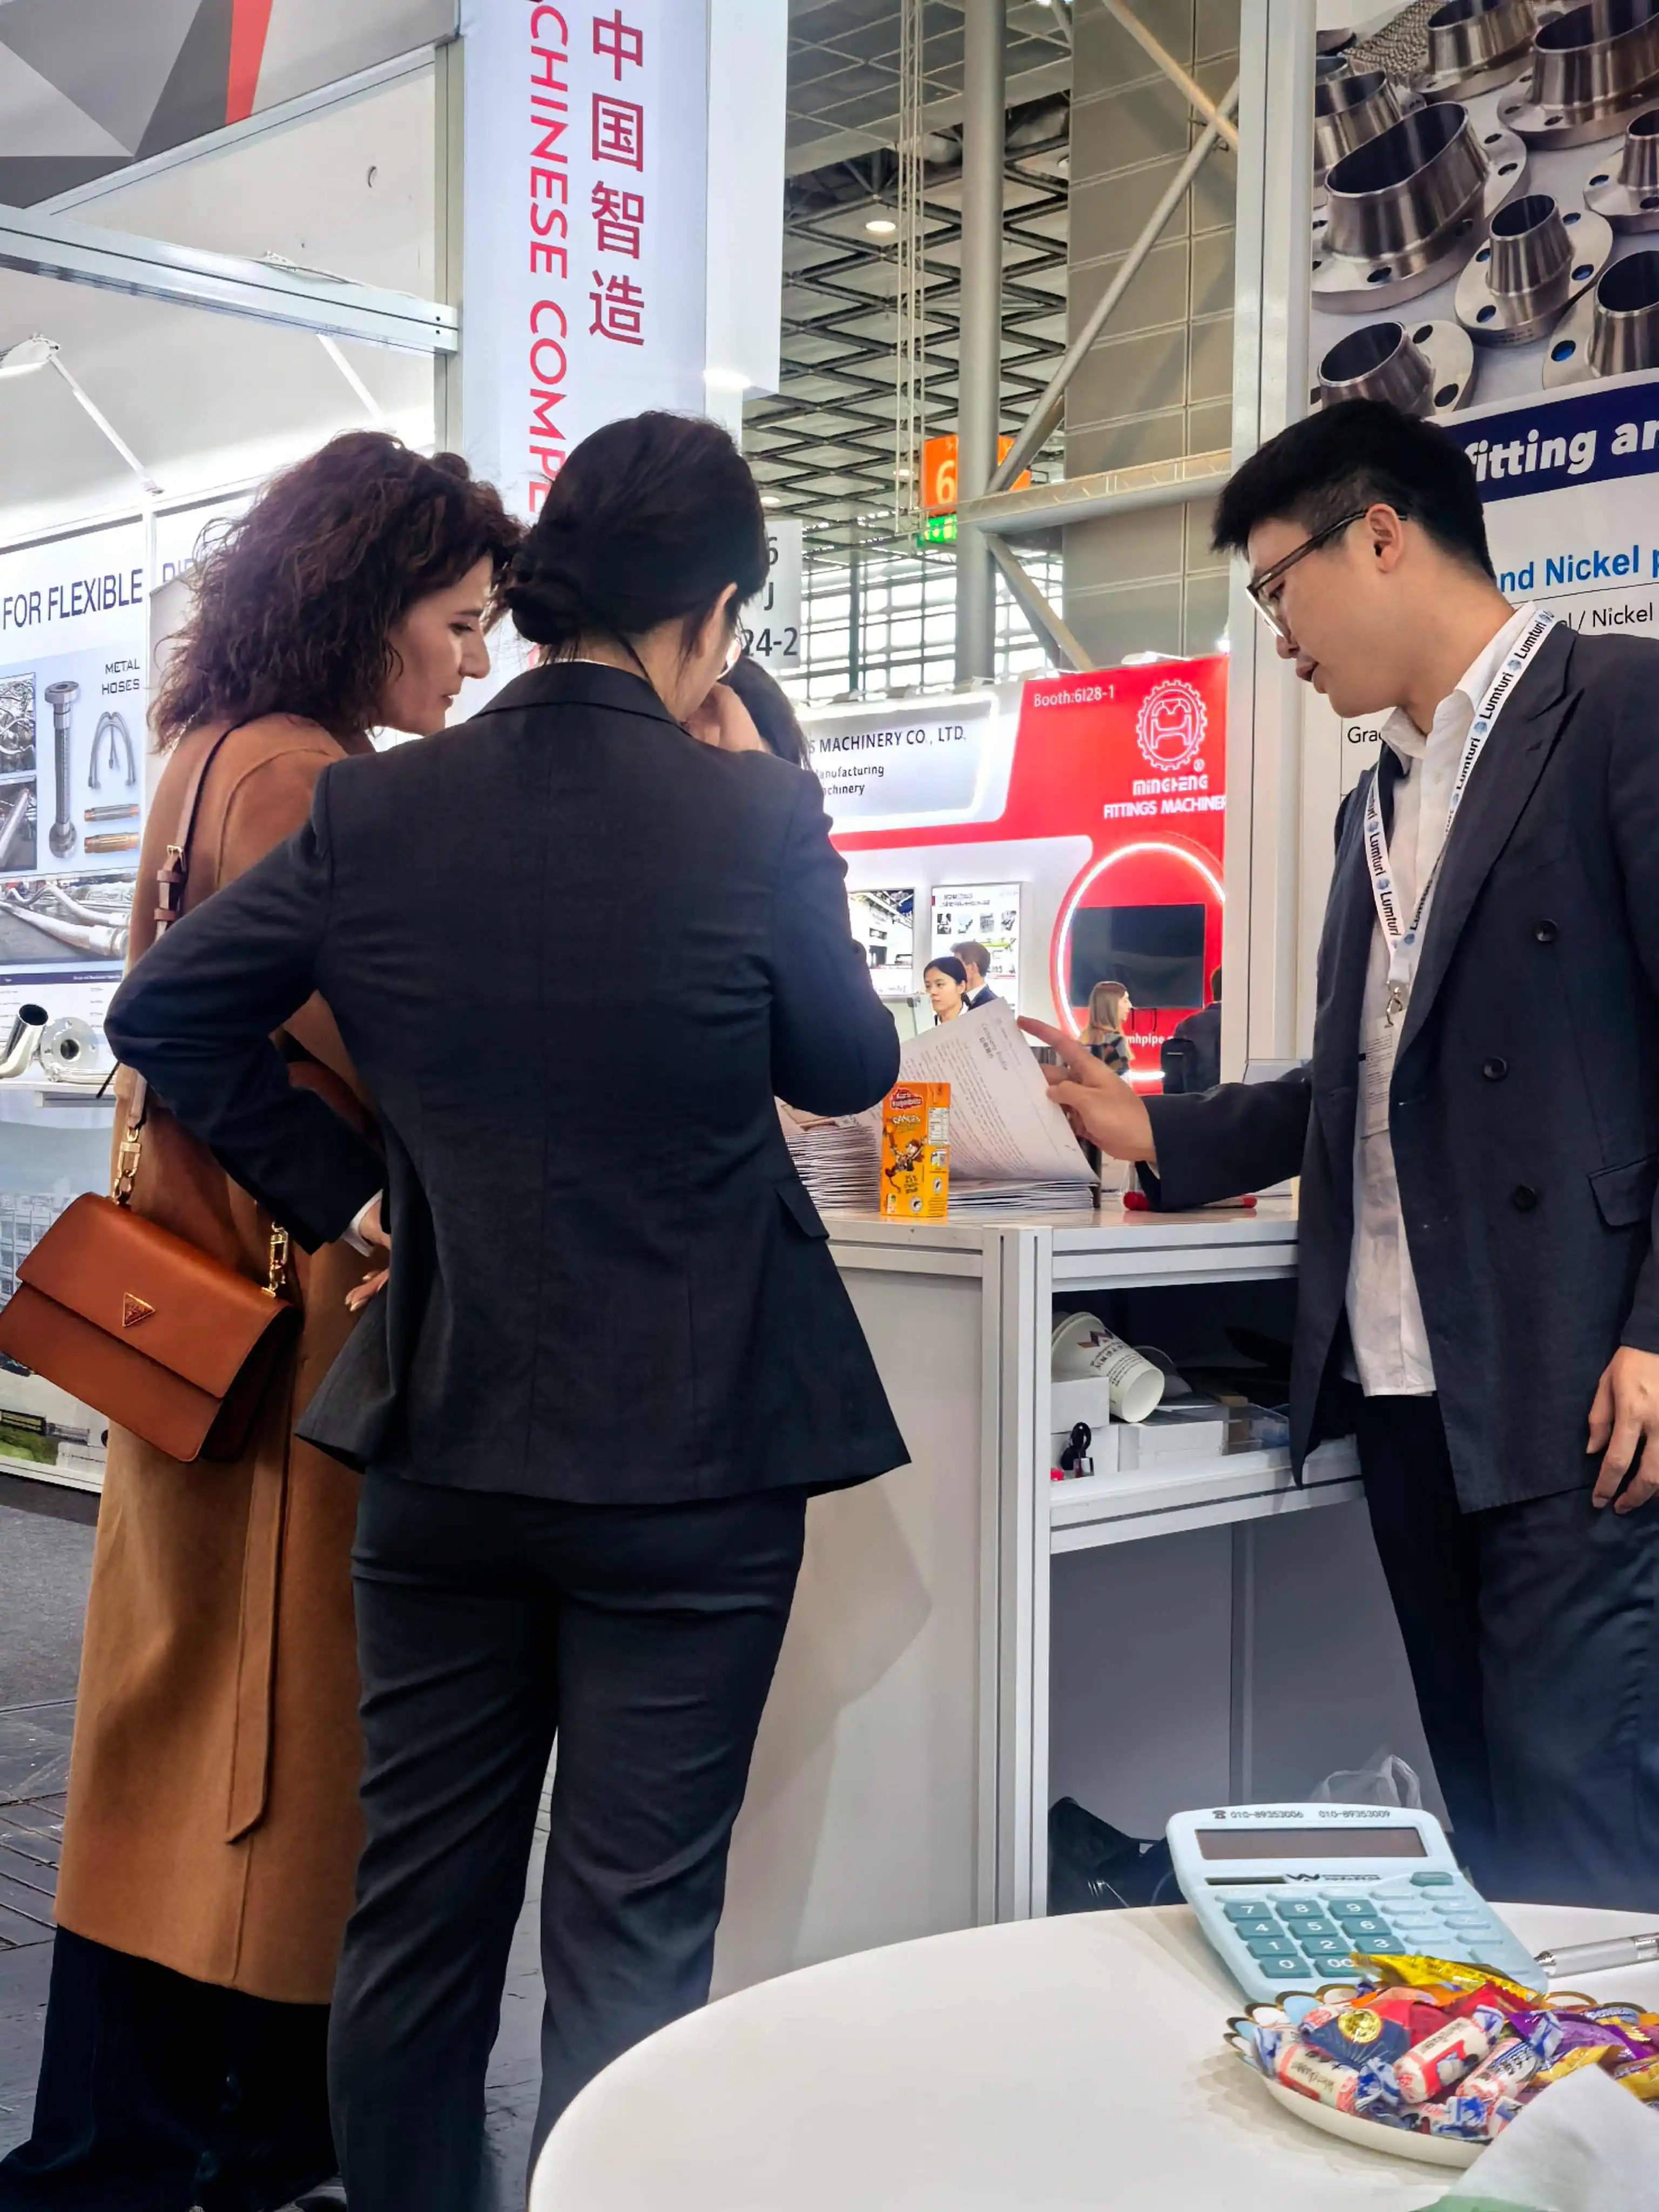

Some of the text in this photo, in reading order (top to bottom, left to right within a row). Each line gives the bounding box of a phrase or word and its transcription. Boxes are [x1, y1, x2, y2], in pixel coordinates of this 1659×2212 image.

[530, 5, 568, 279] CHINESE
[589, 9, 645, 346] 中国智造
[936, 460, 955, 506] 6
[1500, 561, 1534, 592] nd
[1546, 545, 1639, 586] Nickel
[3, 590, 42, 630] FOR
[48, 568, 143, 621] FLEXIBLE
[764, 582, 774, 611] J
[1593, 602, 1653, 628] Nickel
[1514, 621, 1547, 659] Lumturi
[105, 658, 140, 675] METAL
[102, 678, 140, 696] HOSES
[1479, 672, 1514, 720] Lumturi
[819, 731, 903, 753] MACHINERY
[816, 765, 885, 778] anufacturing
[1456, 737, 1480, 790] Lumturi
[822, 785, 865, 796] achinery
[1104, 800, 1157, 819] FITTINGS
[1369, 832, 1386, 876] Lumturi
[1380, 891, 1402, 936] Lumturi
[1240, 1903, 1361, 1914] 7 8 9
[1255, 1920, 1376, 1932] 4 5 6
[1268, 1938, 1391, 1951] 1 2 3
[1279, 1958, 1355, 1969] 0 00
